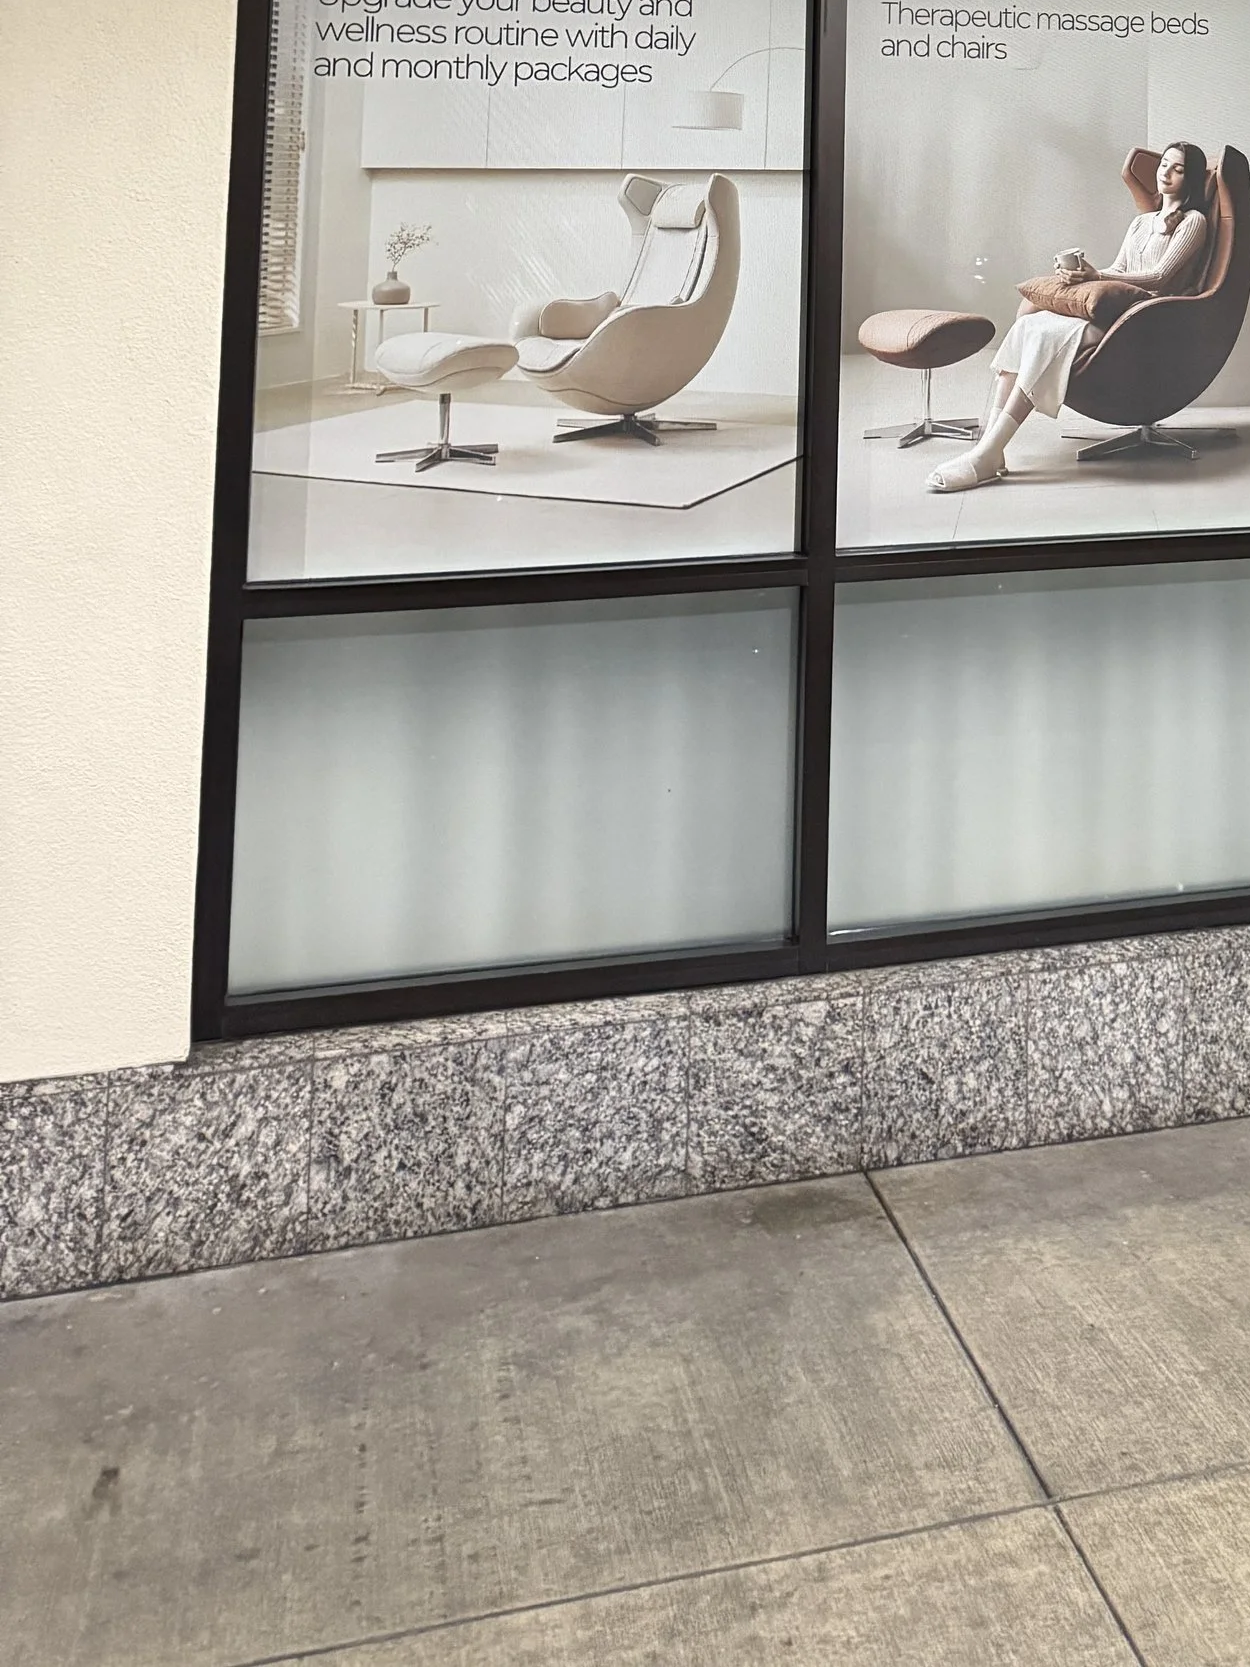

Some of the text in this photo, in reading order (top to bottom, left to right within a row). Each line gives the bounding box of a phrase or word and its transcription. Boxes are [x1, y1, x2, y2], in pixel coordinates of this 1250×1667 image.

[316, 17, 697, 56] wellness routine with daily
[881, 1, 1210, 38] Therapeutic massage beds
[881, 35, 1007, 60] and chairs
[314, 52, 653, 89] and monthly packages
